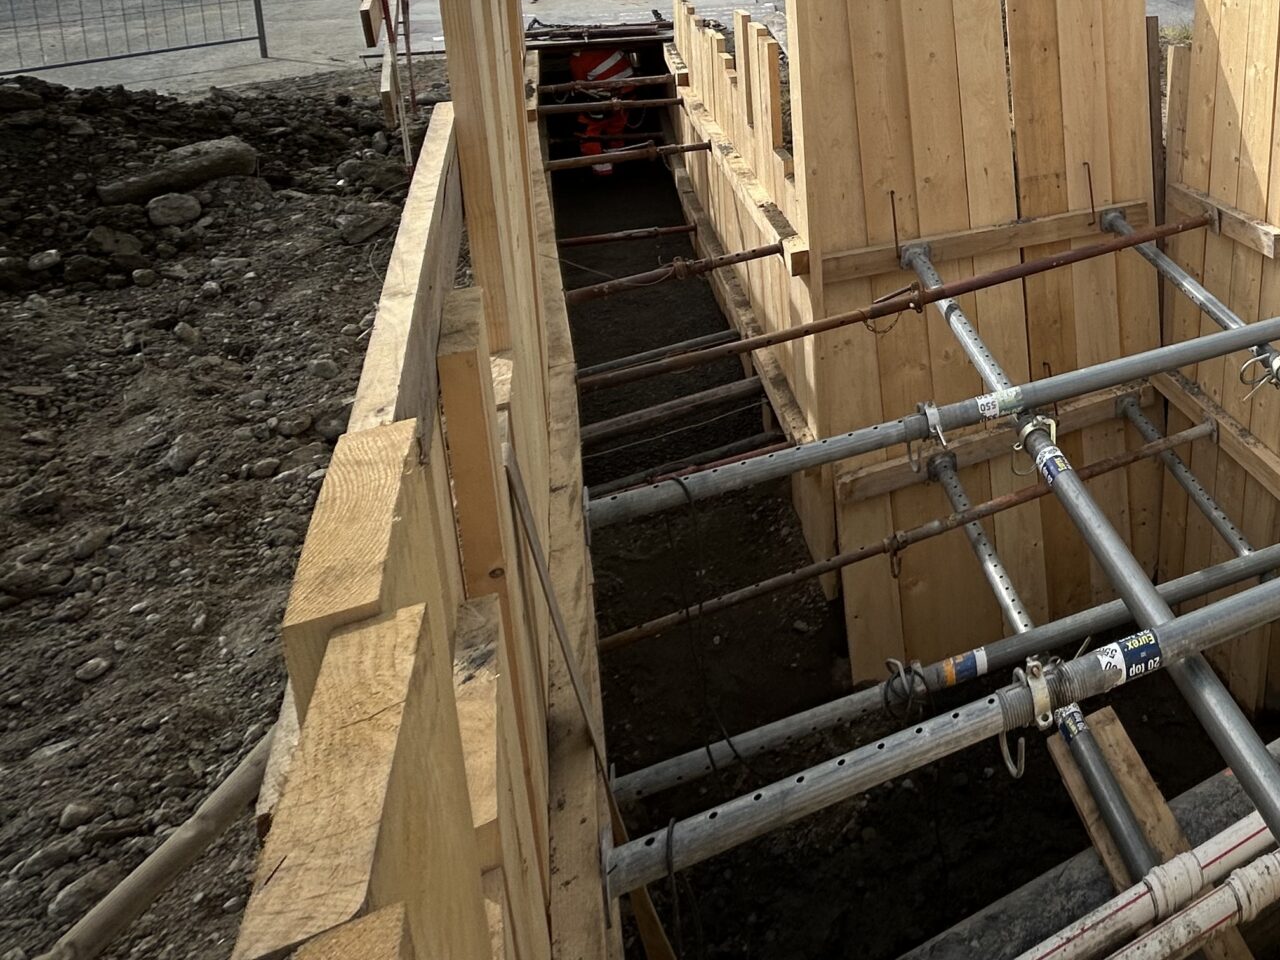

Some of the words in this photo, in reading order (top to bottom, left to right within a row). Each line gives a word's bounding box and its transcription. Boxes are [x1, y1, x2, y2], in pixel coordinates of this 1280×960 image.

[980, 400, 997, 412] 550
[1125, 633, 1156, 651] Eurex
[1129, 662, 1145, 677] top
[1147, 656, 1160, 670] 20
